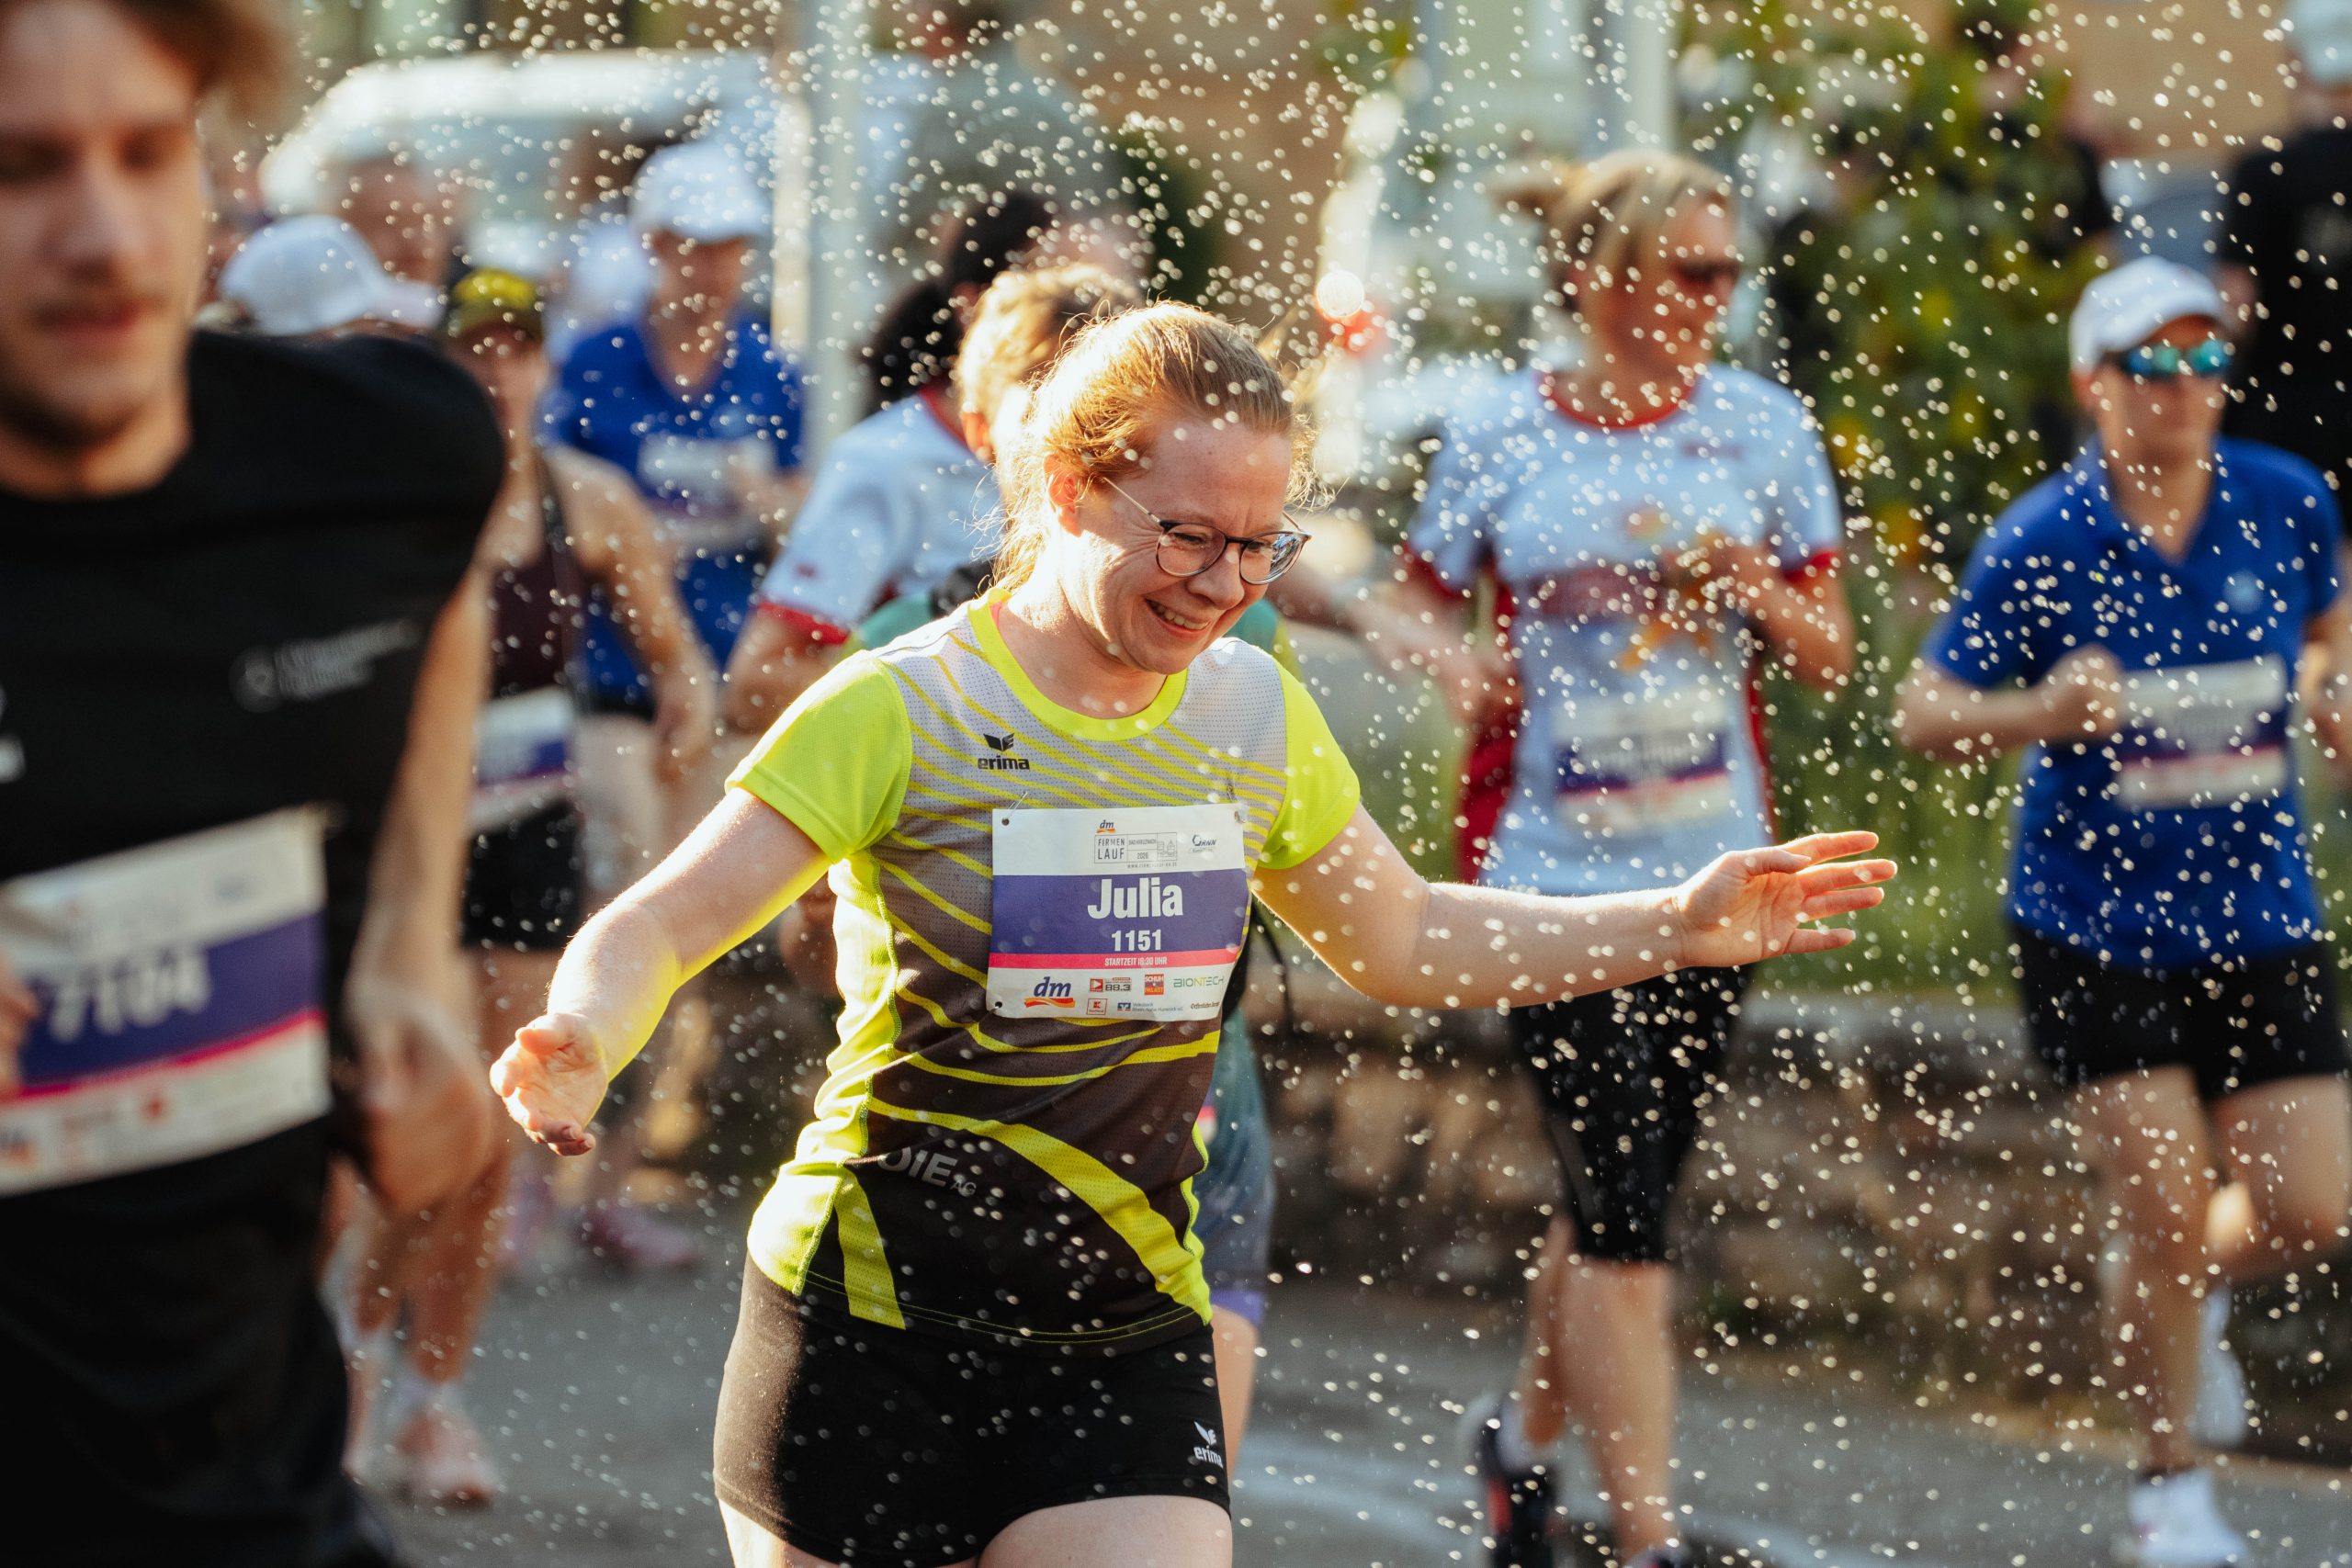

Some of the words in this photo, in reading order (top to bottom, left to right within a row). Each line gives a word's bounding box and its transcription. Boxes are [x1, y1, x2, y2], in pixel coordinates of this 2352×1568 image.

[978, 755, 1030, 770] erima
[1099, 819, 1114, 829] dm
[1098, 838, 1125, 846] FIRMEN
[1097, 847, 1125, 860] LAUF
[1087, 876, 1184, 919] Julia
[1111, 929, 1162, 953] 1151
[1104, 957, 1136, 966] STARTZEIT
[1155, 956, 1168, 965] UHR
[1033, 976, 1072, 998] dm
[1173, 976, 1224, 988] BIONTECH
[949, 1179, 977, 1197] AG
[1193, 1445, 1224, 1469] erima
